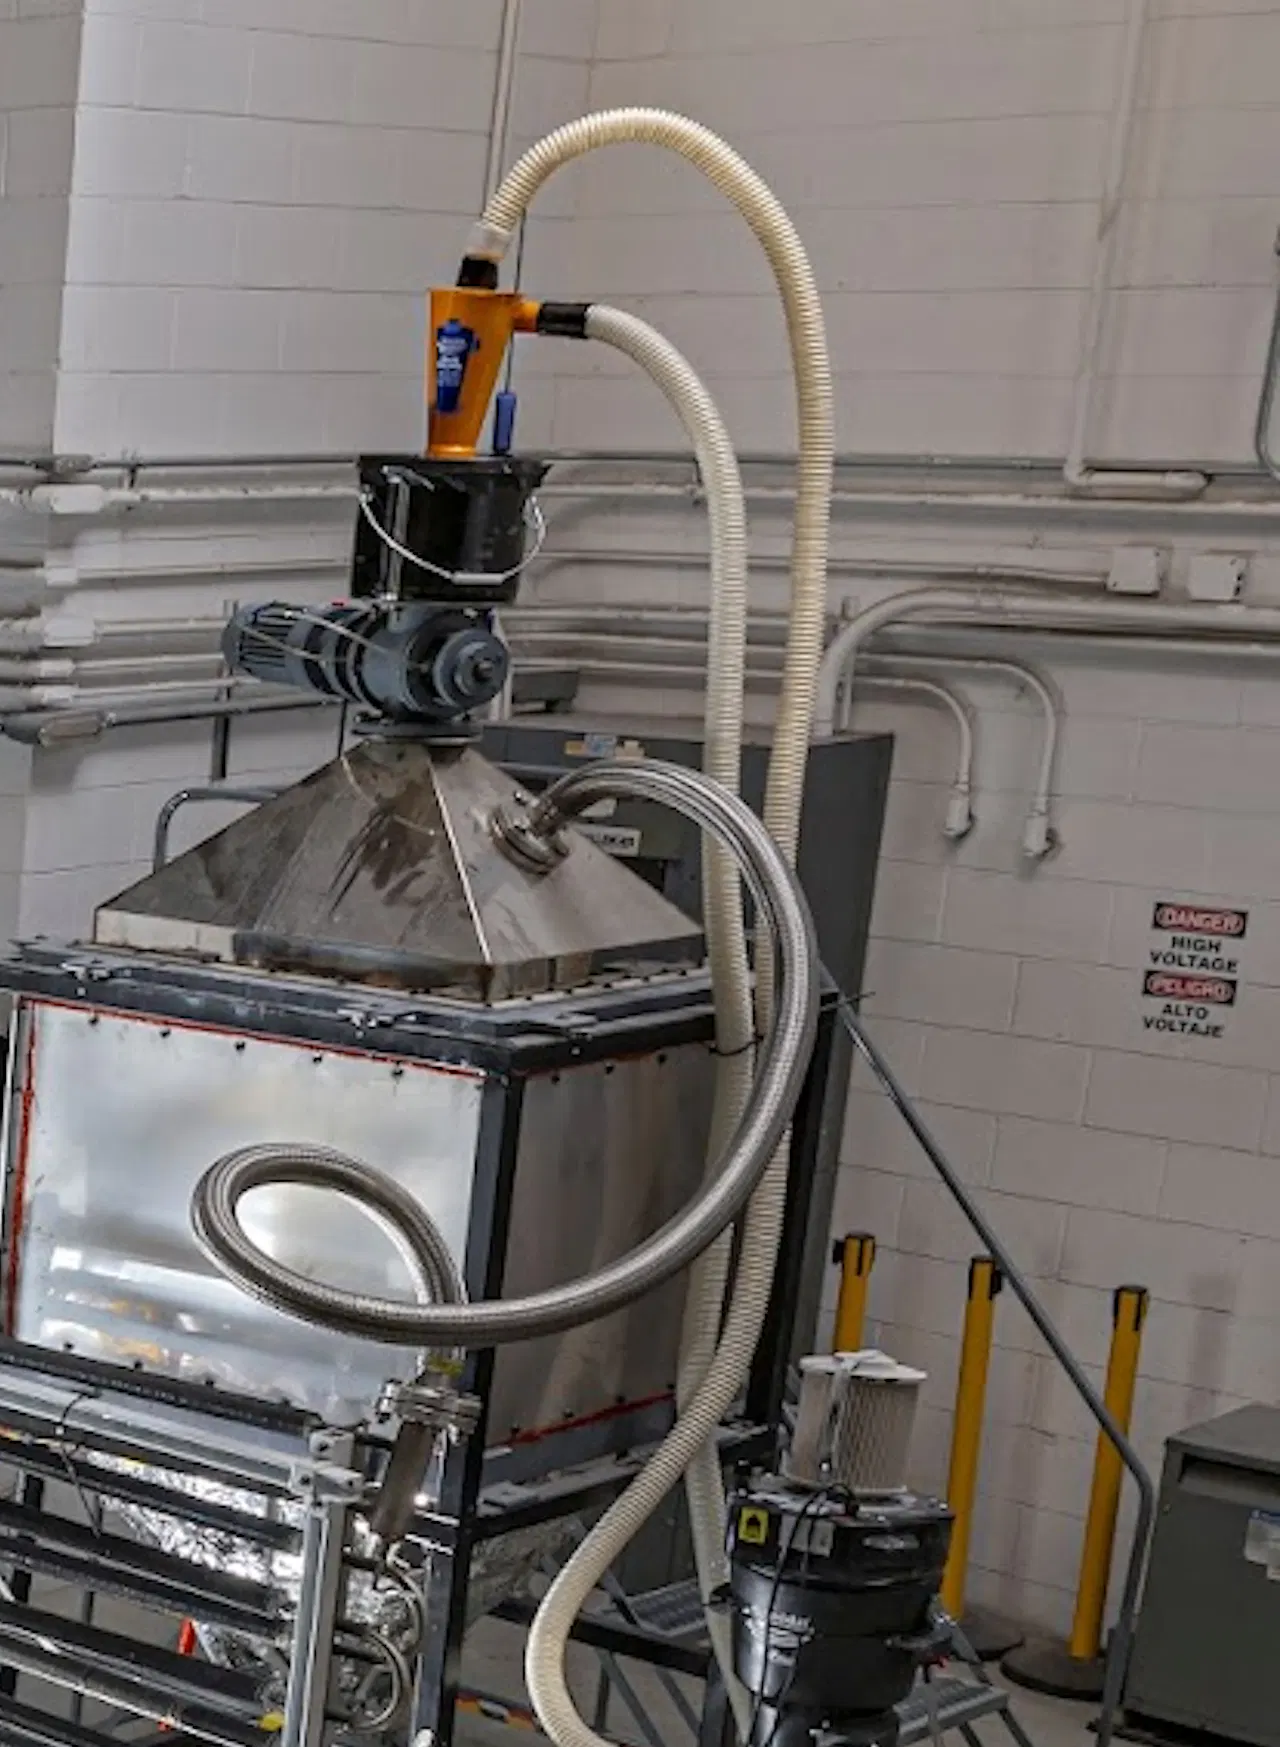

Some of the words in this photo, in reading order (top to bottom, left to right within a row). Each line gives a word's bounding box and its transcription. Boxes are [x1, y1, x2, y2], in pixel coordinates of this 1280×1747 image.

[1162, 906, 1241, 932] DANGER
[1171, 936, 1221, 953] HIGH
[1150, 950, 1238, 973] VOLTAGE
[1151, 977, 1225, 1000] PELIGRO
[1162, 1003, 1209, 1020] ALTO
[1143, 1016, 1224, 1038] VOLTAJE
